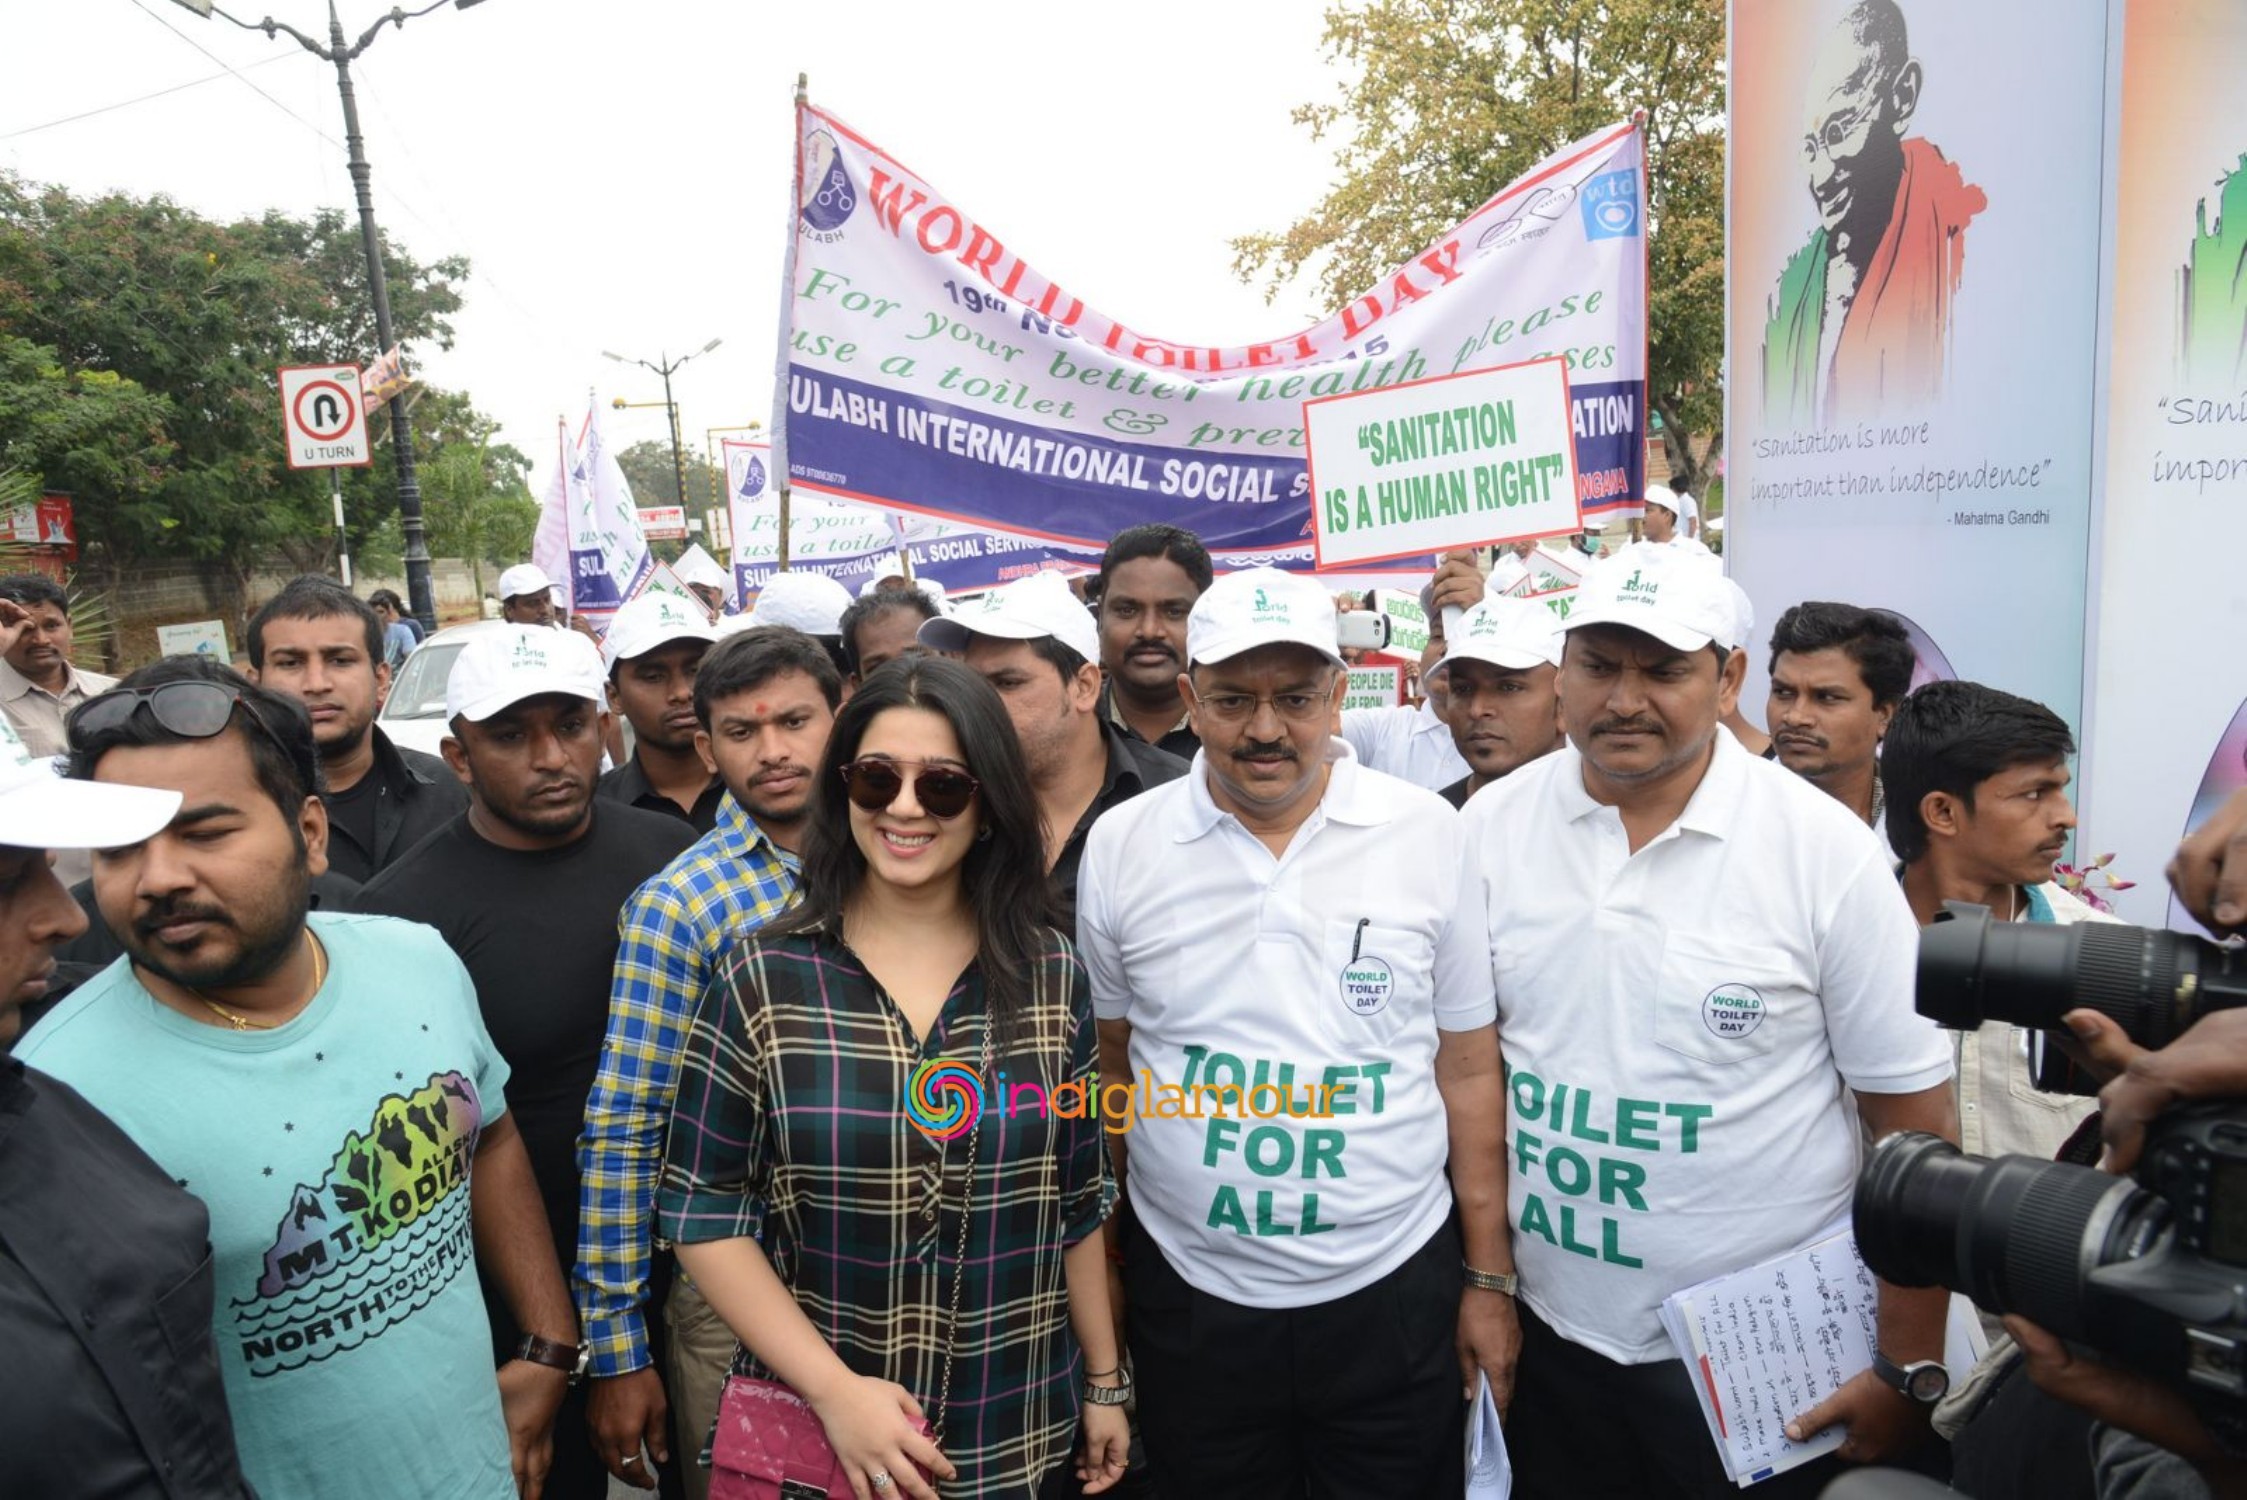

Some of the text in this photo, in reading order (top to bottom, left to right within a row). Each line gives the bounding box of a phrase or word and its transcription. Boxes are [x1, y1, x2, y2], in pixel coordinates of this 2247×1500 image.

[867, 165, 1084, 327] WORLD
[1339, 239, 1463, 342] DAY
[798, 268, 901, 320] For
[905, 311, 1024, 365] your
[1048, 350, 1201, 402] better
[1450, 289, 1603, 374] please
[879, 356, 916, 378] a
[938, 367, 1076, 420] toilet
[1103, 408, 1168, 434] &
[304, 446, 355, 460] U TURN
[790, 373, 888, 434] ULABH
[896, 404, 1149, 491] INTERNATIONAL
[1160, 458, 1278, 504] SOCIAL
[1857, 427, 1875, 449] is
[1880, 421, 1930, 447] more
[1325, 487, 1349, 534] IS
[1356, 485, 1374, 529] A
[1376, 469, 1469, 526] HUMAN
[1751, 476, 1834, 506] important
[1838, 472, 1885, 496] than
[1954, 511, 2005, 526] Mahatma
[2008, 509, 2051, 526] Gandhi
[930, 539, 983, 562] SOCIAL
[1345, 970, 1387, 982] WORLD
[1347, 984, 1388, 995] TOILET
[1356, 996, 1379, 1008] DAY
[1710, 1008, 1759, 1021] TOILET
[1712, 994, 1760, 1009] WORLD
[1719, 1022, 1746, 1033] DAY
[1181, 1044, 1392, 1115] TOILET
[1203, 1117, 1346, 1179] FOR
[1515, 1128, 1649, 1211] FOR
[1206, 1184, 1337, 1237] ALL
[1519, 1194, 1644, 1270] ALL
[240, 1292, 387, 1363] NORTH
